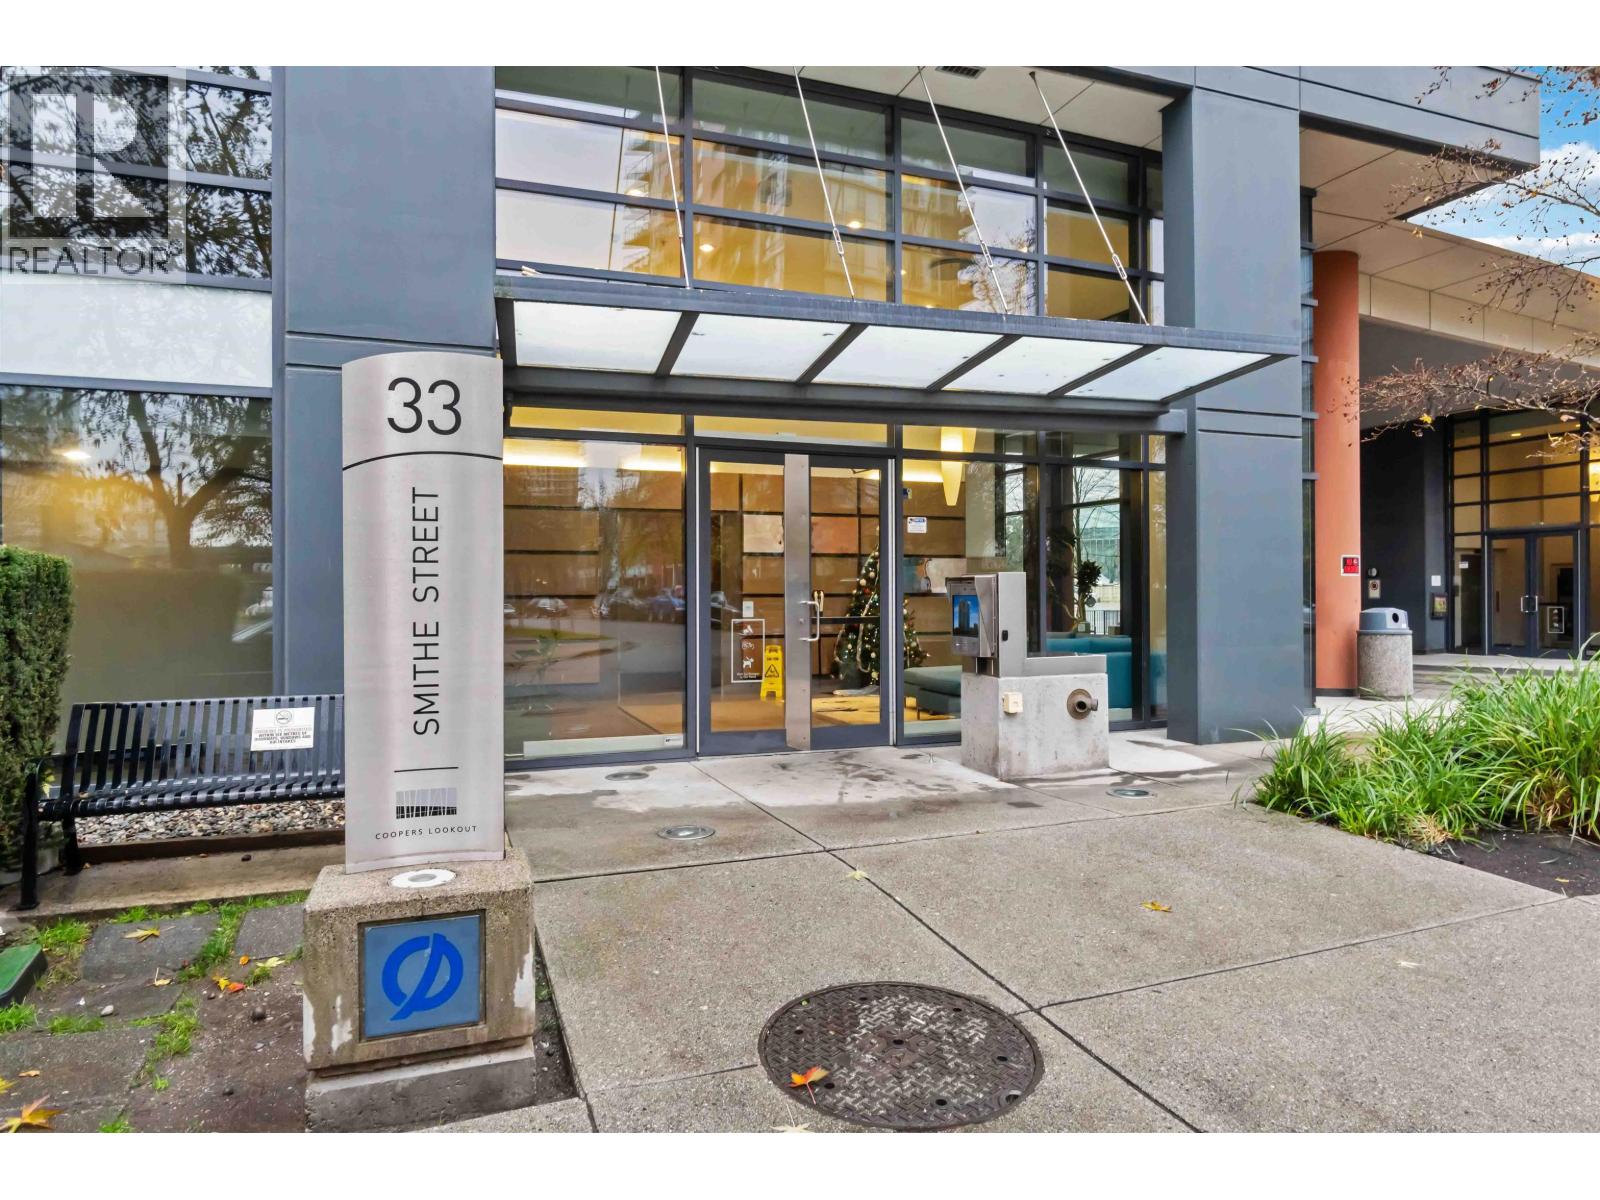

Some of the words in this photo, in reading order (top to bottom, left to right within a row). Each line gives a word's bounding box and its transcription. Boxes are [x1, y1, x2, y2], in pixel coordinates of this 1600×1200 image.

[387, 376, 462, 436] 33
[411, 486, 440, 602] STREET
[412, 621, 440, 735] SMITHE
[375, 828, 423, 840] COOPERS
[428, 825, 477, 835] LOOKOUT
